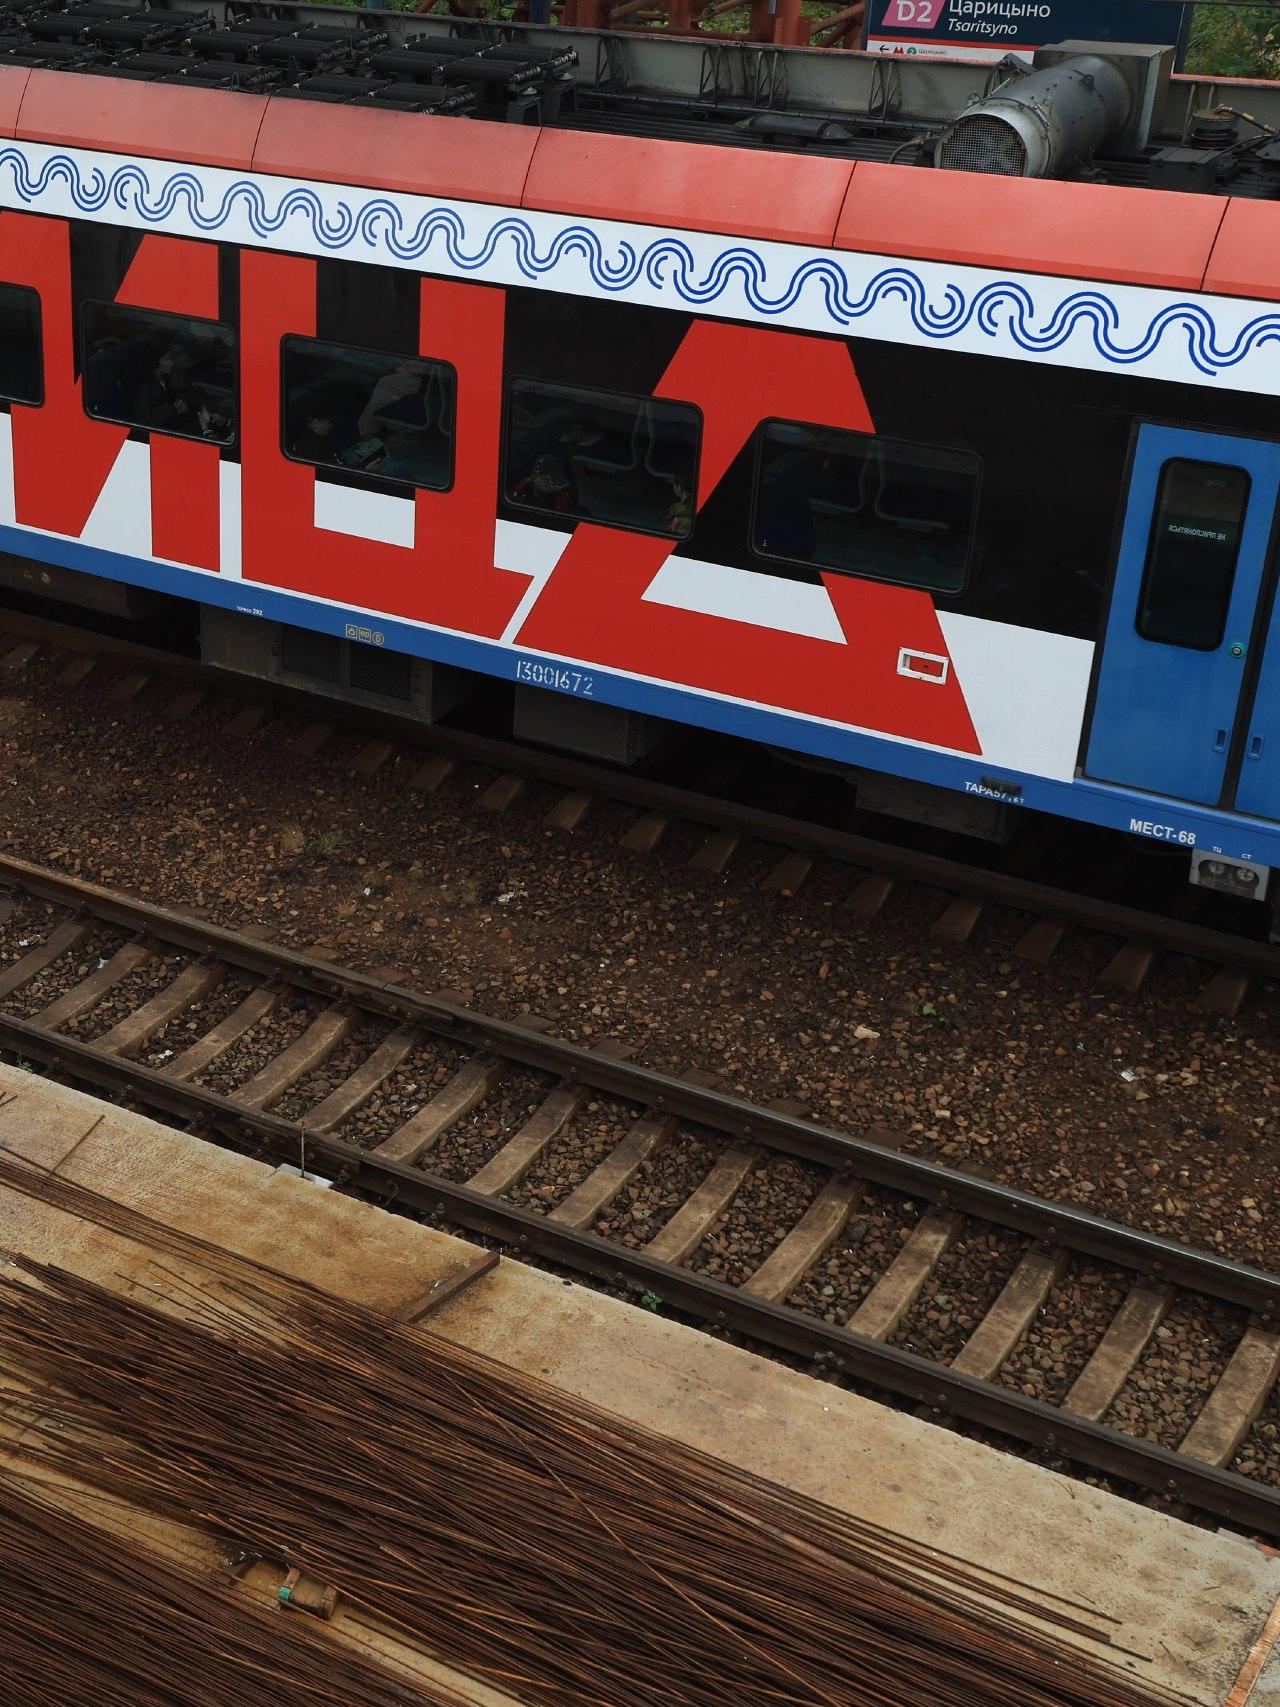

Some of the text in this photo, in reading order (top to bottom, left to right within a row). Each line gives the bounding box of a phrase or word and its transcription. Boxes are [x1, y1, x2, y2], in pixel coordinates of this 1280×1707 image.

[897, 0, 933, 23] D2
[949, 0, 1051, 18] Царицыно
[948, 18, 1018, 37] Tsaritsyno
[252, 608, 263, 616] 292
[516, 659, 593, 696] 13001672
[1129, 818, 1196, 845] МЕСТ-68
